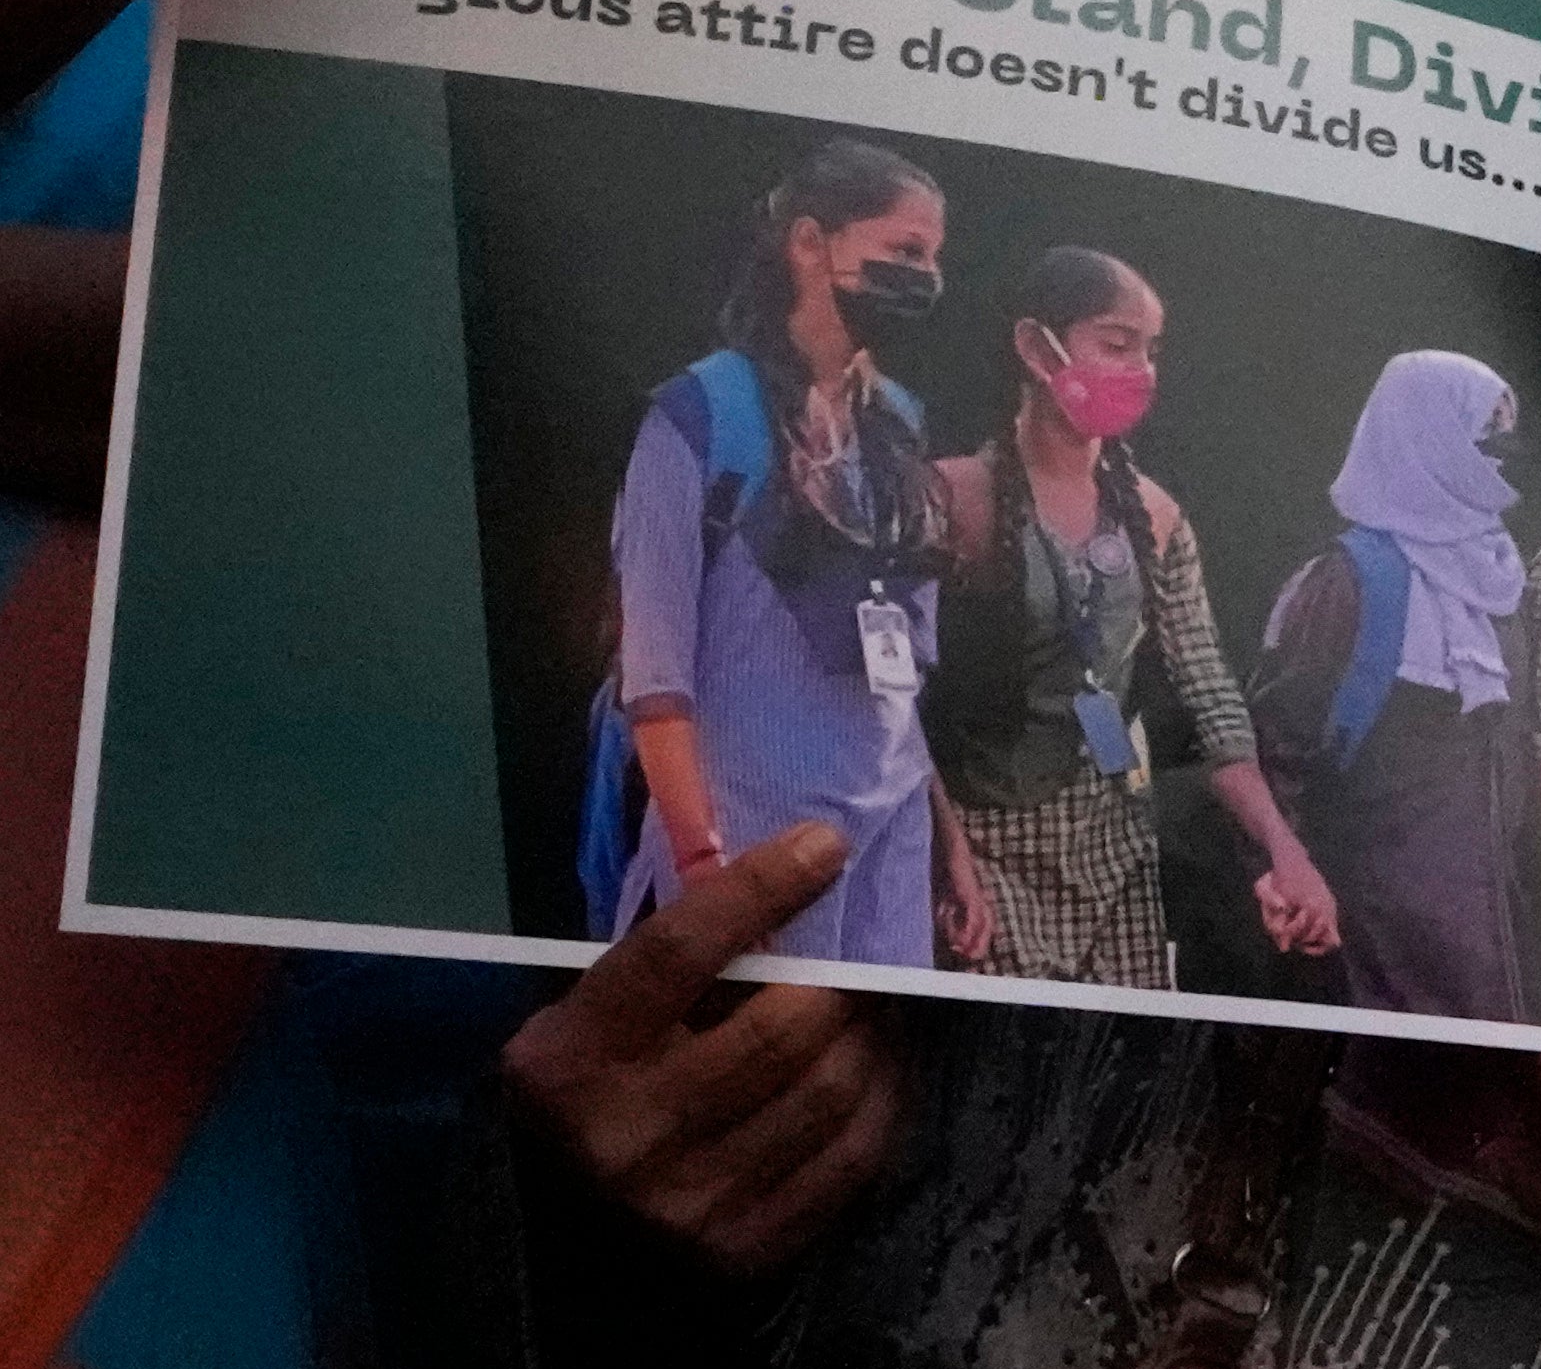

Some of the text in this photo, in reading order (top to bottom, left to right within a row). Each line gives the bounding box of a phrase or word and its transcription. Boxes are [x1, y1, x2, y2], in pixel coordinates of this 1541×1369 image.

[656, 0, 876, 63] attire
[898, 26, 1160, 112] doesn't
[1178, 72, 1399, 160] divide
